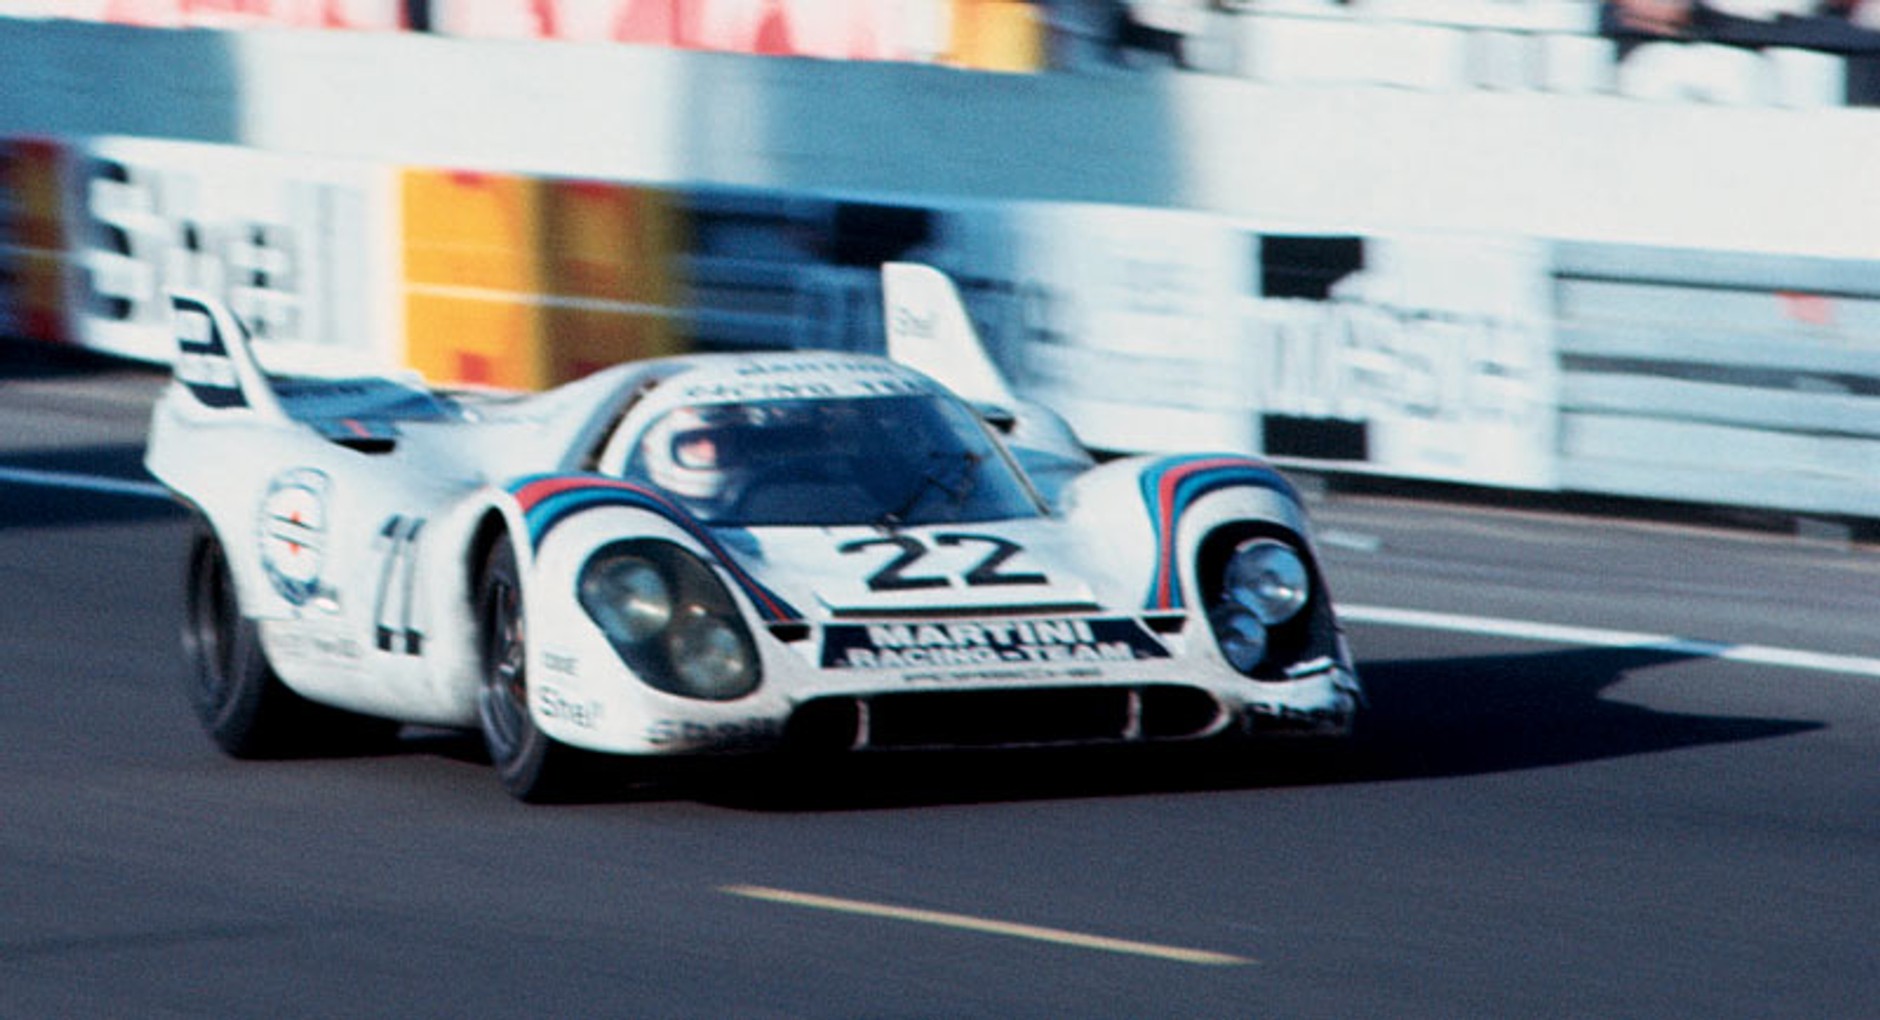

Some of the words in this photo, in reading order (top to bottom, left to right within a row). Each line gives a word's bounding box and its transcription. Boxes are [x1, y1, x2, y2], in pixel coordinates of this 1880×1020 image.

[836, 532, 1048, 592] 22
[866, 618, 1097, 650] MARTINI
[538, 685, 602, 728] Shell
